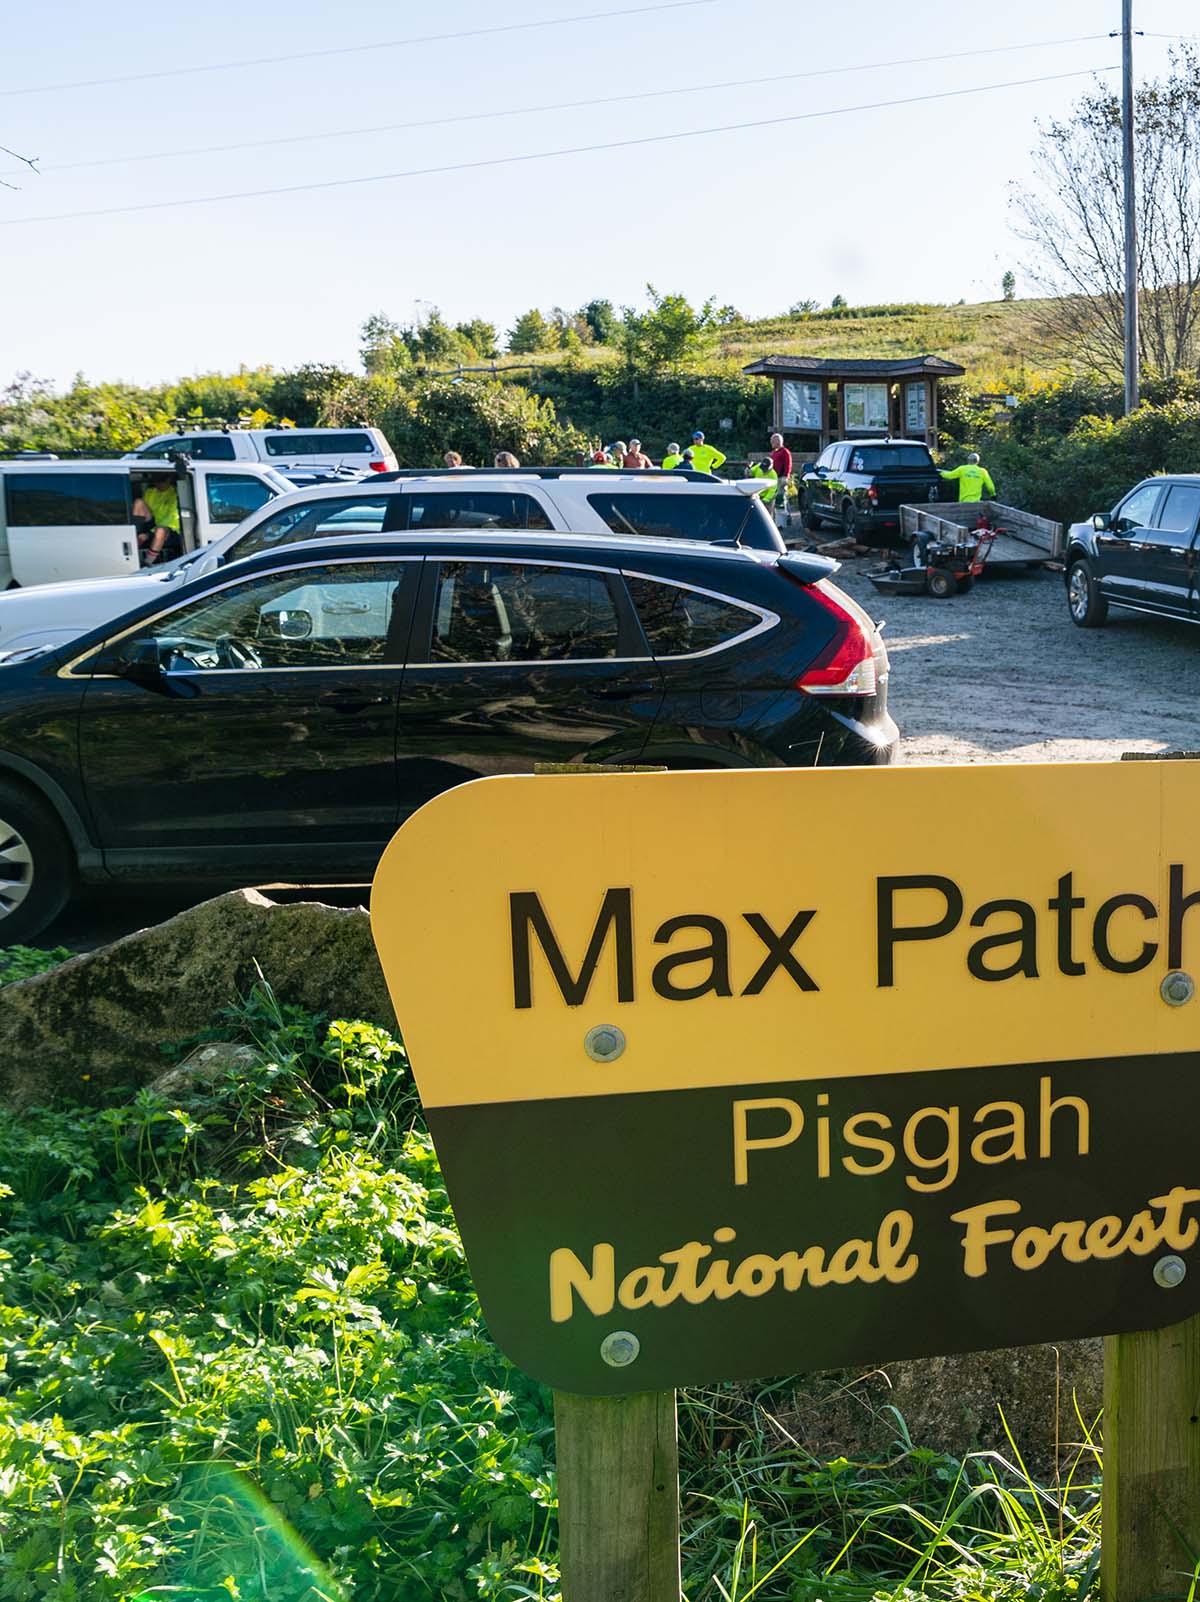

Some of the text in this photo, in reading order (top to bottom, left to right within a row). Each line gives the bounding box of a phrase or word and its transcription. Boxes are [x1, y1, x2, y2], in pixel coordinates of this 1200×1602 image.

[509, 887, 821, 1010] Max
[732, 1076, 1090, 1193] Pisgah
[549, 1209, 919, 1323] National
